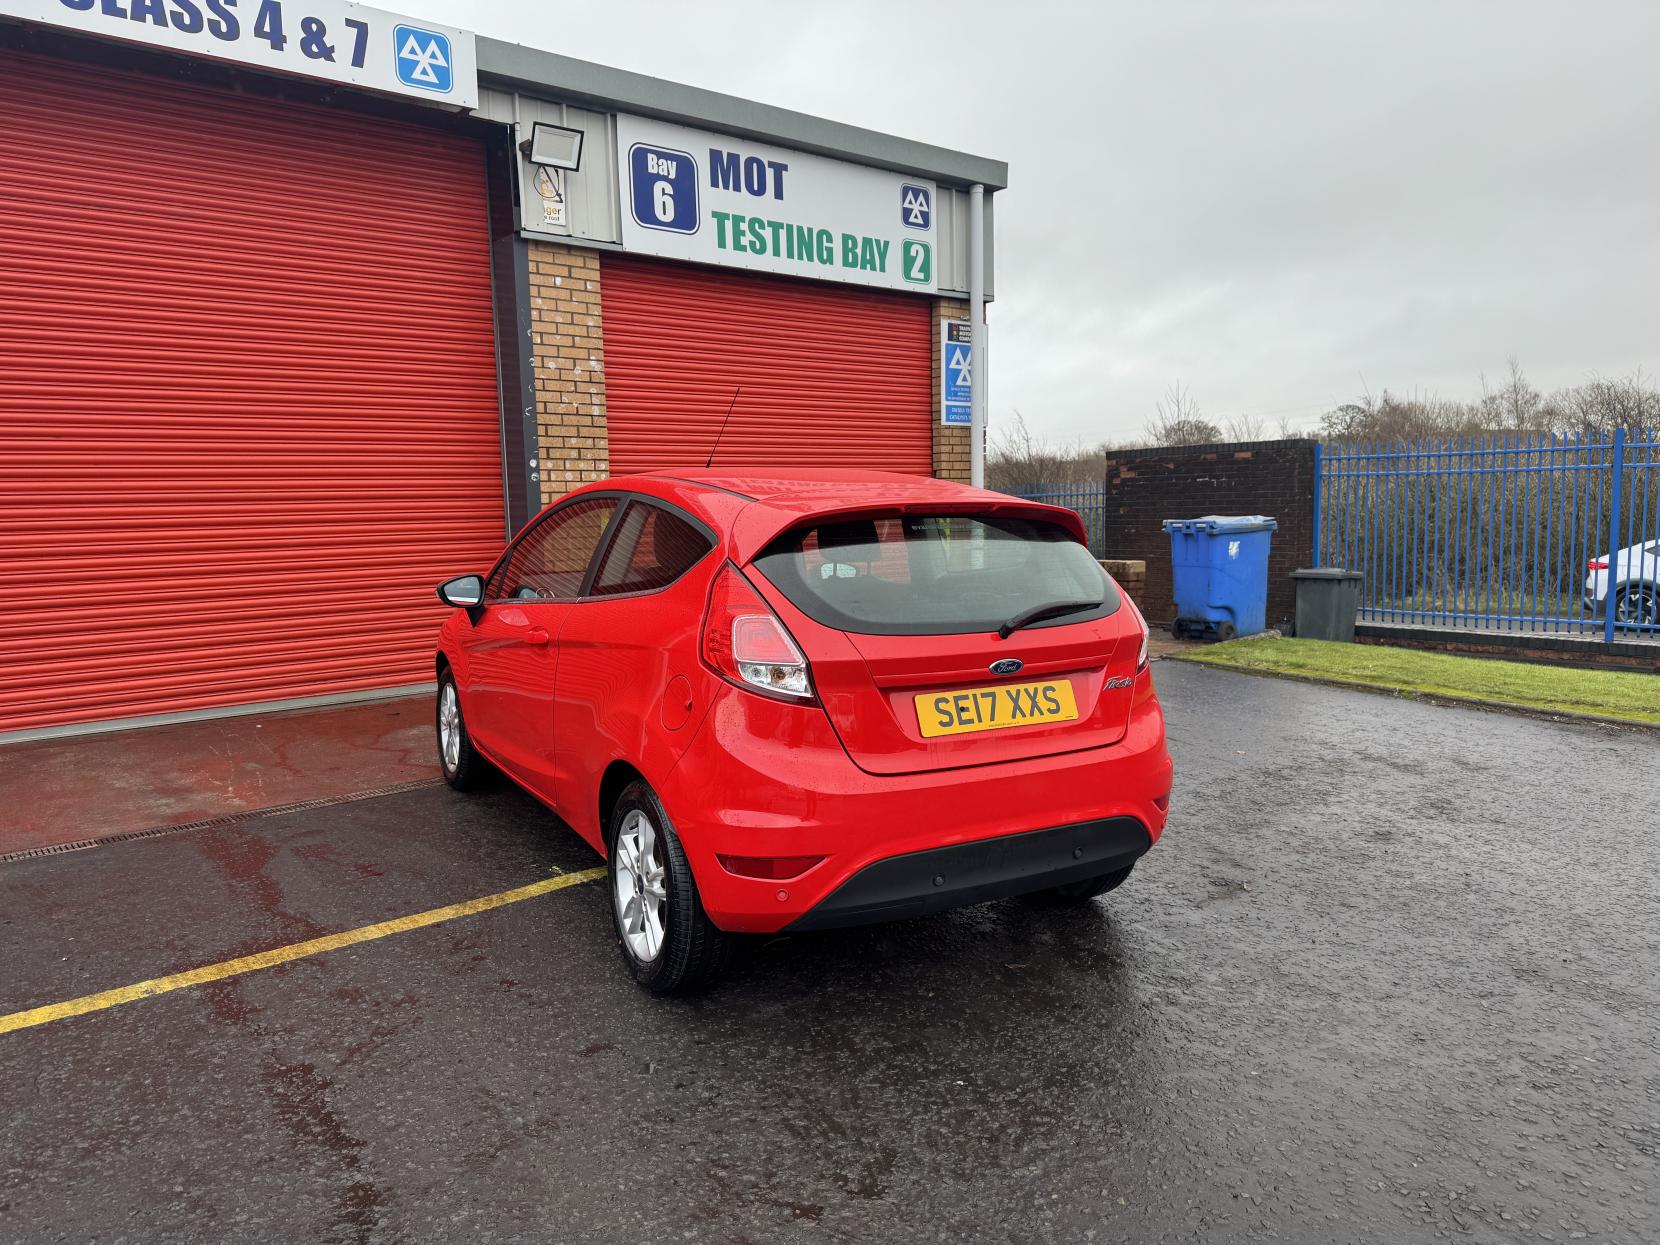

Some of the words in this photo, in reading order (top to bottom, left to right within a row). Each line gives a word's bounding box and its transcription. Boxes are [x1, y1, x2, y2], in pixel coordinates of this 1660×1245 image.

[58, 0, 240, 42] ASS
[253, 0, 287, 52] 4
[299, 16, 336, 63] &
[345, 17, 369, 69] 7
[647, 152, 677, 179] Bay
[709, 148, 789, 201] MOT
[653, 180, 675, 223] 6
[711, 210, 834, 266] TESTING
[841, 232, 890, 273] BAY
[910, 246, 925, 280] 2
[934, 691, 997, 728] SE17
[1006, 686, 1061, 720] XXS
